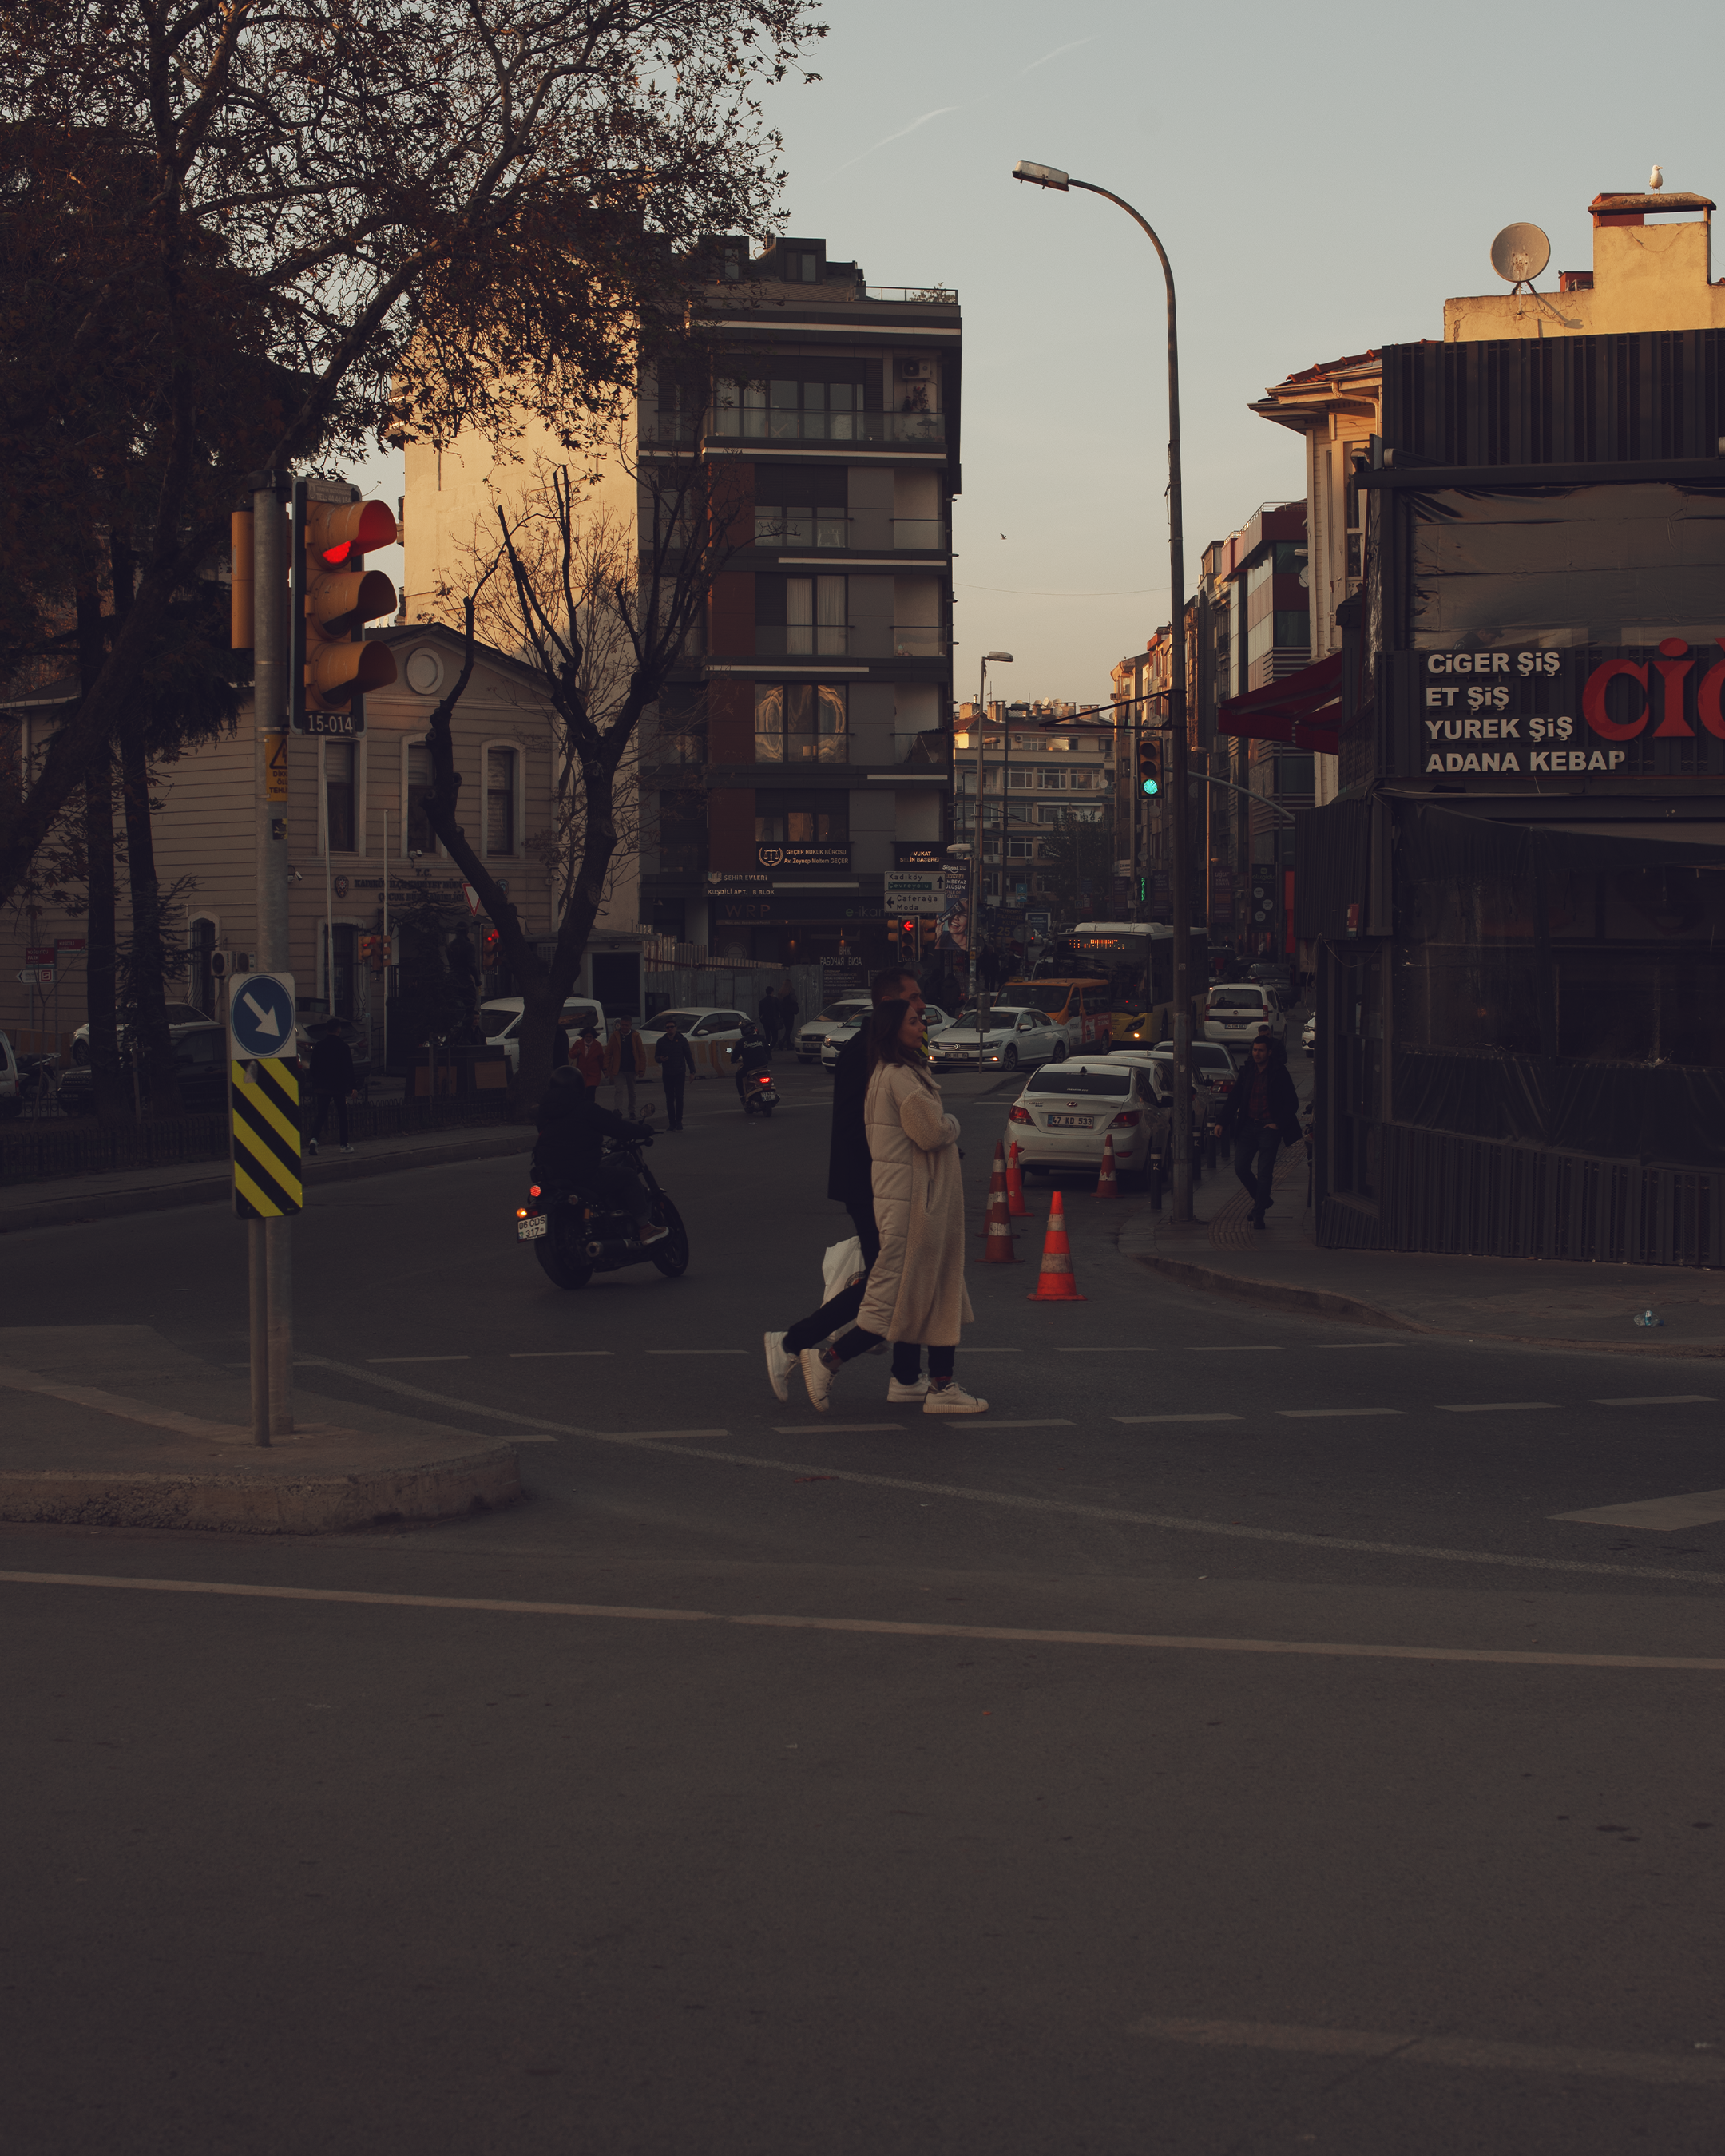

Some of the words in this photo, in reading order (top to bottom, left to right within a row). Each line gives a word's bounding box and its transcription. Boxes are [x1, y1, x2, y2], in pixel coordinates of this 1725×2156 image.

[1426, 687, 1460, 707] ET
[309, 715, 353, 733] 15-014
[1425, 718, 1521, 740] YUREK
[1426, 752, 1521, 773] ADANA
[1530, 750, 1626, 771] KEBAP
[355, 878, 386, 888] KADIKÖ
[379, 892, 405, 902] ÇCUK
[725, 904, 771, 917] WRP
[997, 927, 1011, 936] 25
[820, 957, 844, 966] РАБОЧАЯ
[848, 957, 862, 966] ВИЗА
